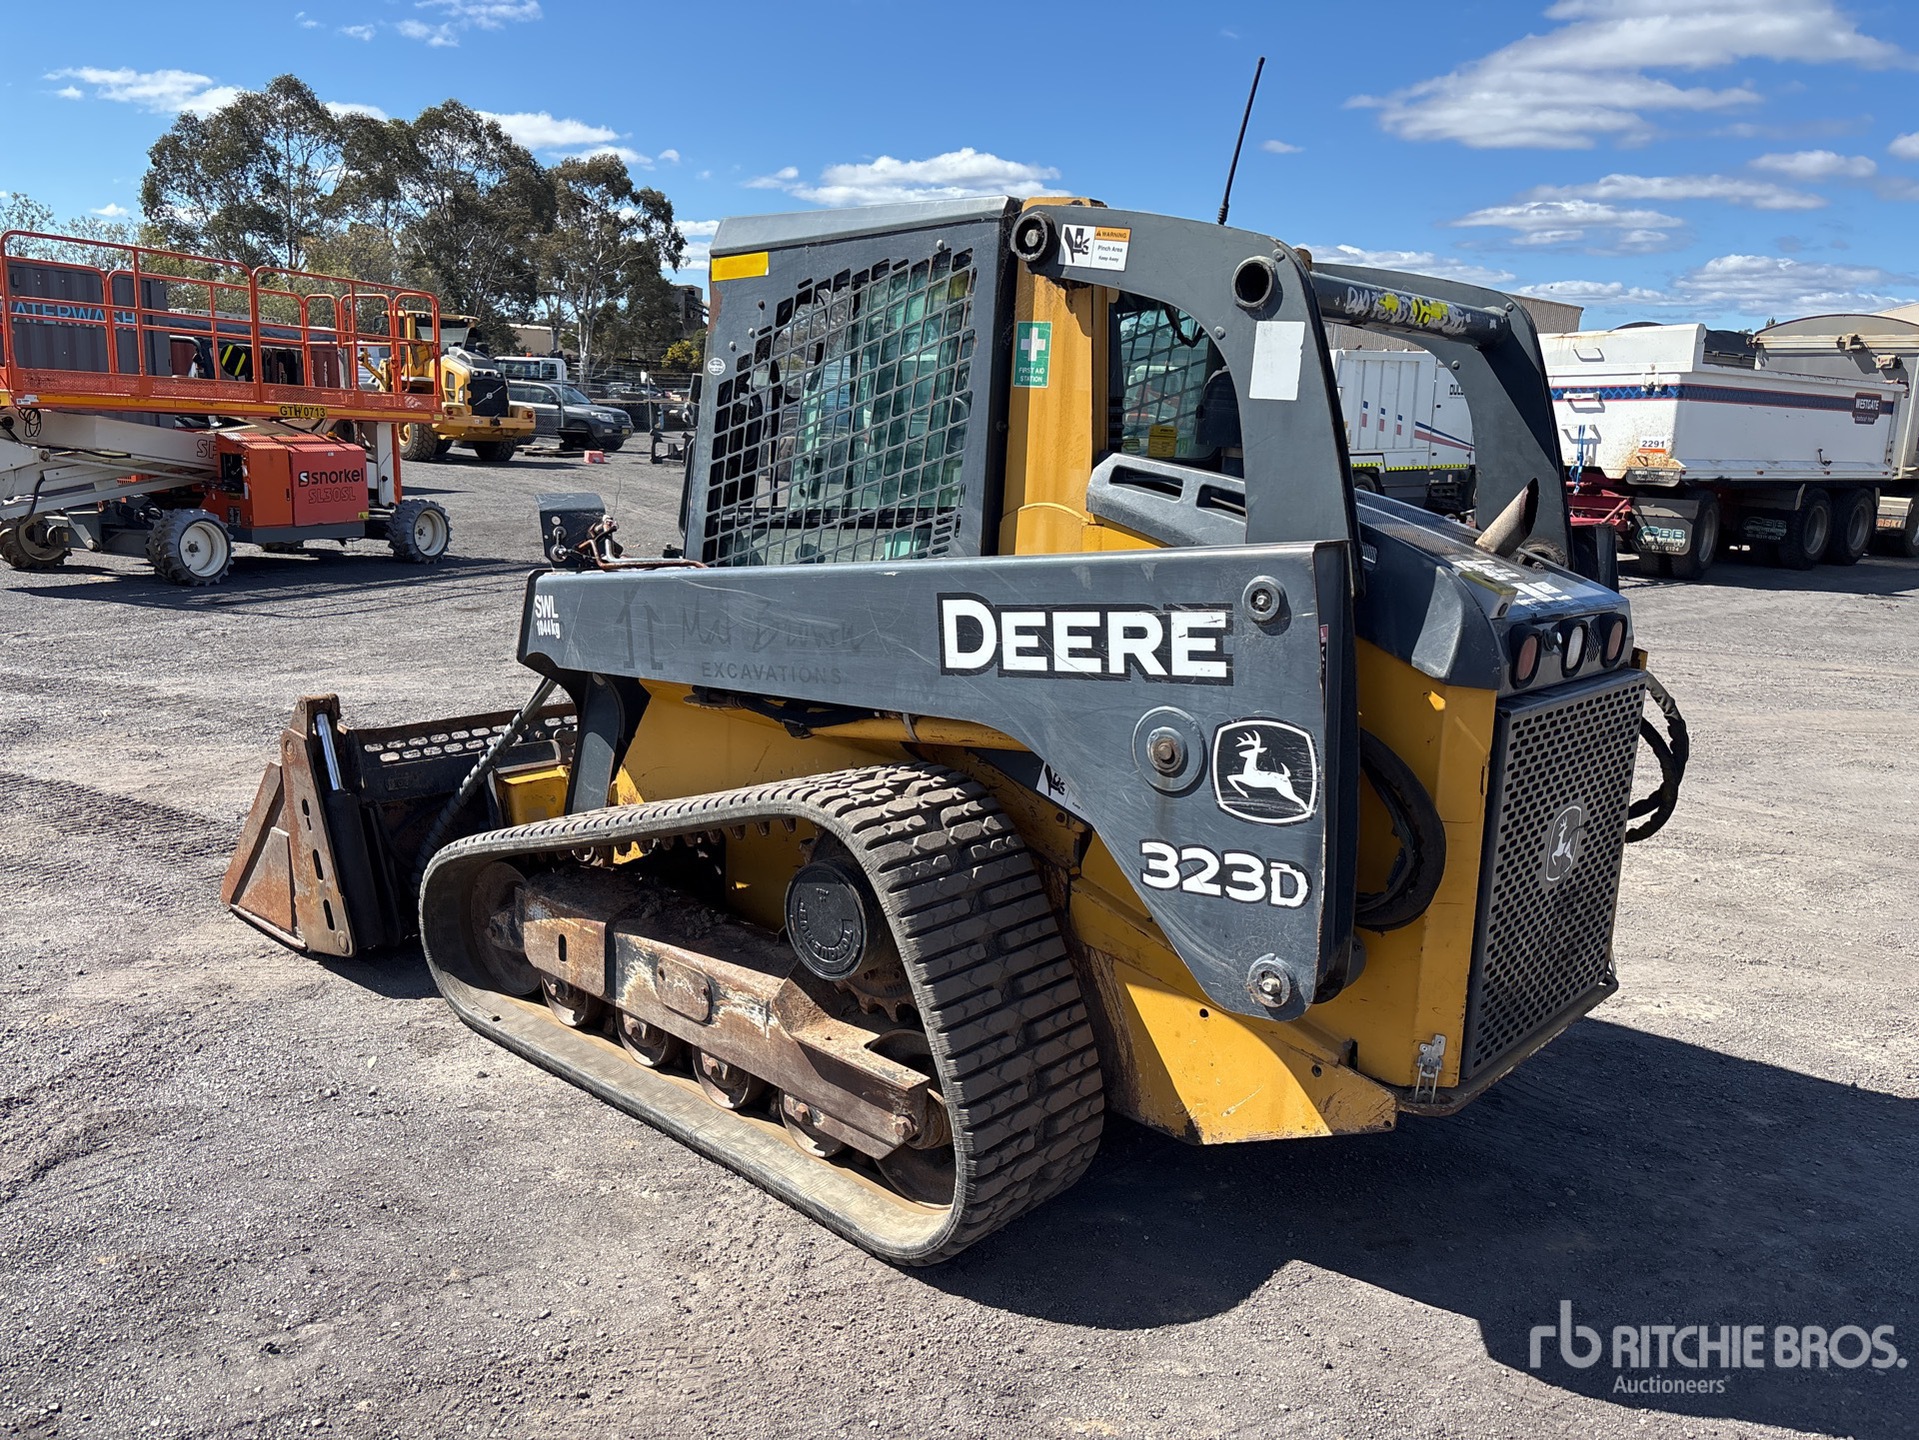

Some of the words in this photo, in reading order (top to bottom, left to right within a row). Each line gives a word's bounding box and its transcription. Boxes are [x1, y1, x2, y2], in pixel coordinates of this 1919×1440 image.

[1101, 231, 1127, 239] WARNING
[1098, 244, 1111, 252] Pinch
[1035, 367, 1045, 375] AID
[1020, 375, 1043, 383] STATION
[1855, 398, 1880, 410] WESTGATE
[303, 406, 326, 418] 0713
[1641, 439, 1665, 448] 2291
[311, 467, 364, 485] snorkel
[308, 486, 357, 504] SL30SL
[534, 594, 559, 619] SWL
[940, 597, 1229, 680] DEERE
[701, 661, 843, 686] EXCAVATIONS
[1139, 840, 1310, 908] 323D
